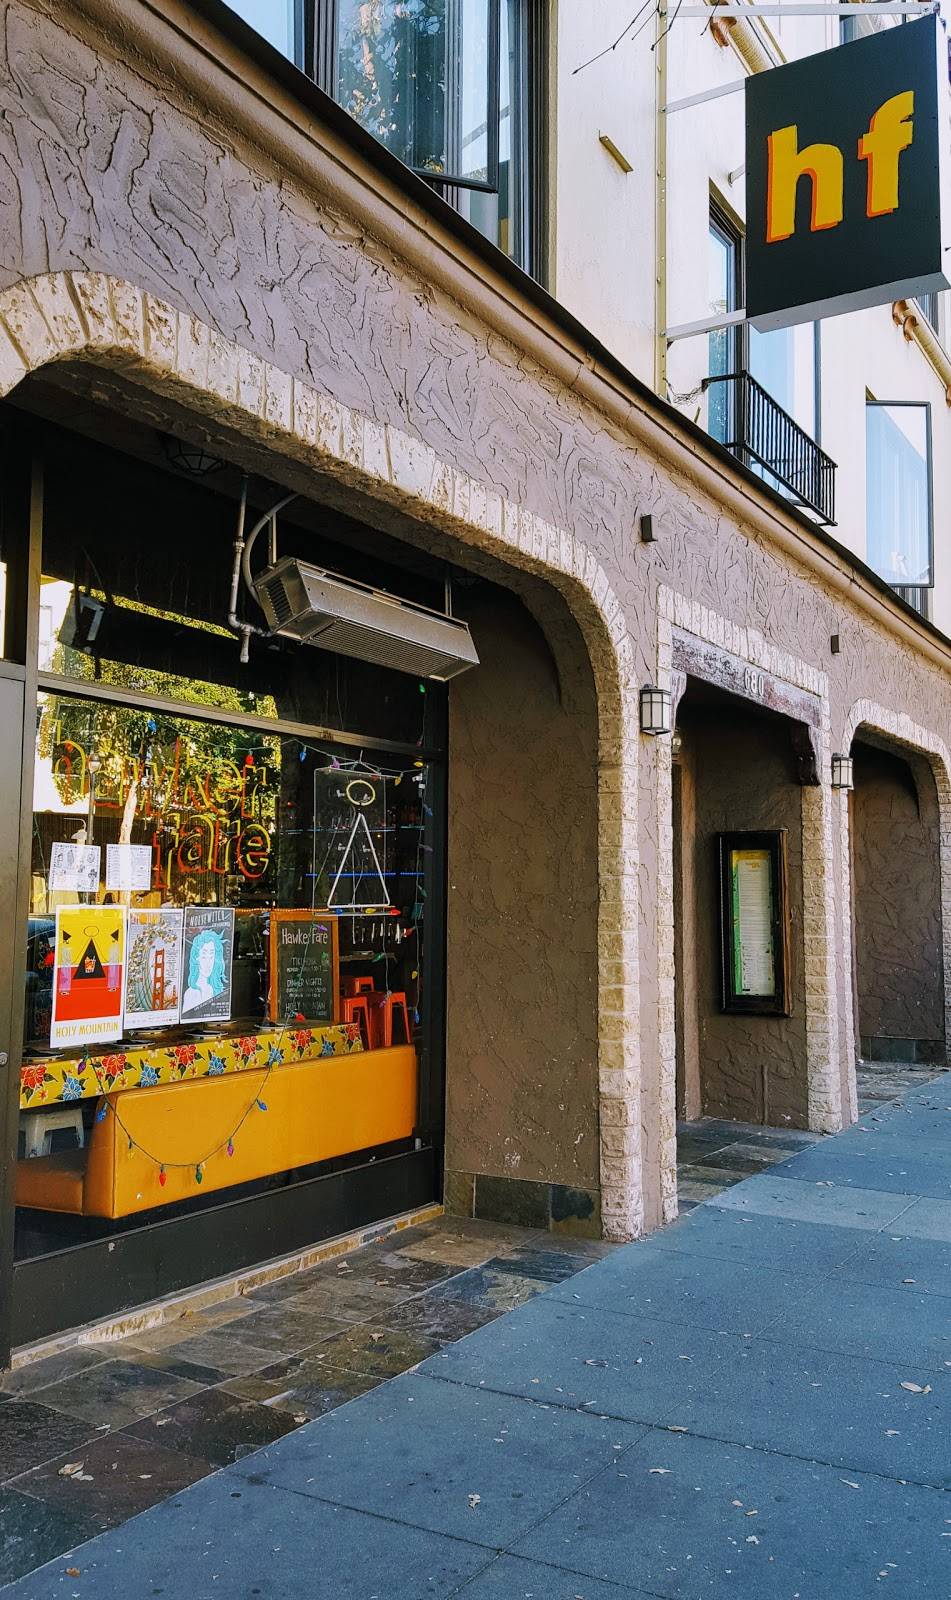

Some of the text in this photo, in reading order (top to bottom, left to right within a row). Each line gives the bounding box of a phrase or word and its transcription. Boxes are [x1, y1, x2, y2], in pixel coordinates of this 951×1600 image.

[766, 90, 914, 243] hf
[744, 666, 764, 697] 680
[311, 927, 328, 945] Fare
[56, 1022, 119, 1038] HOLY MOUNTAIN
